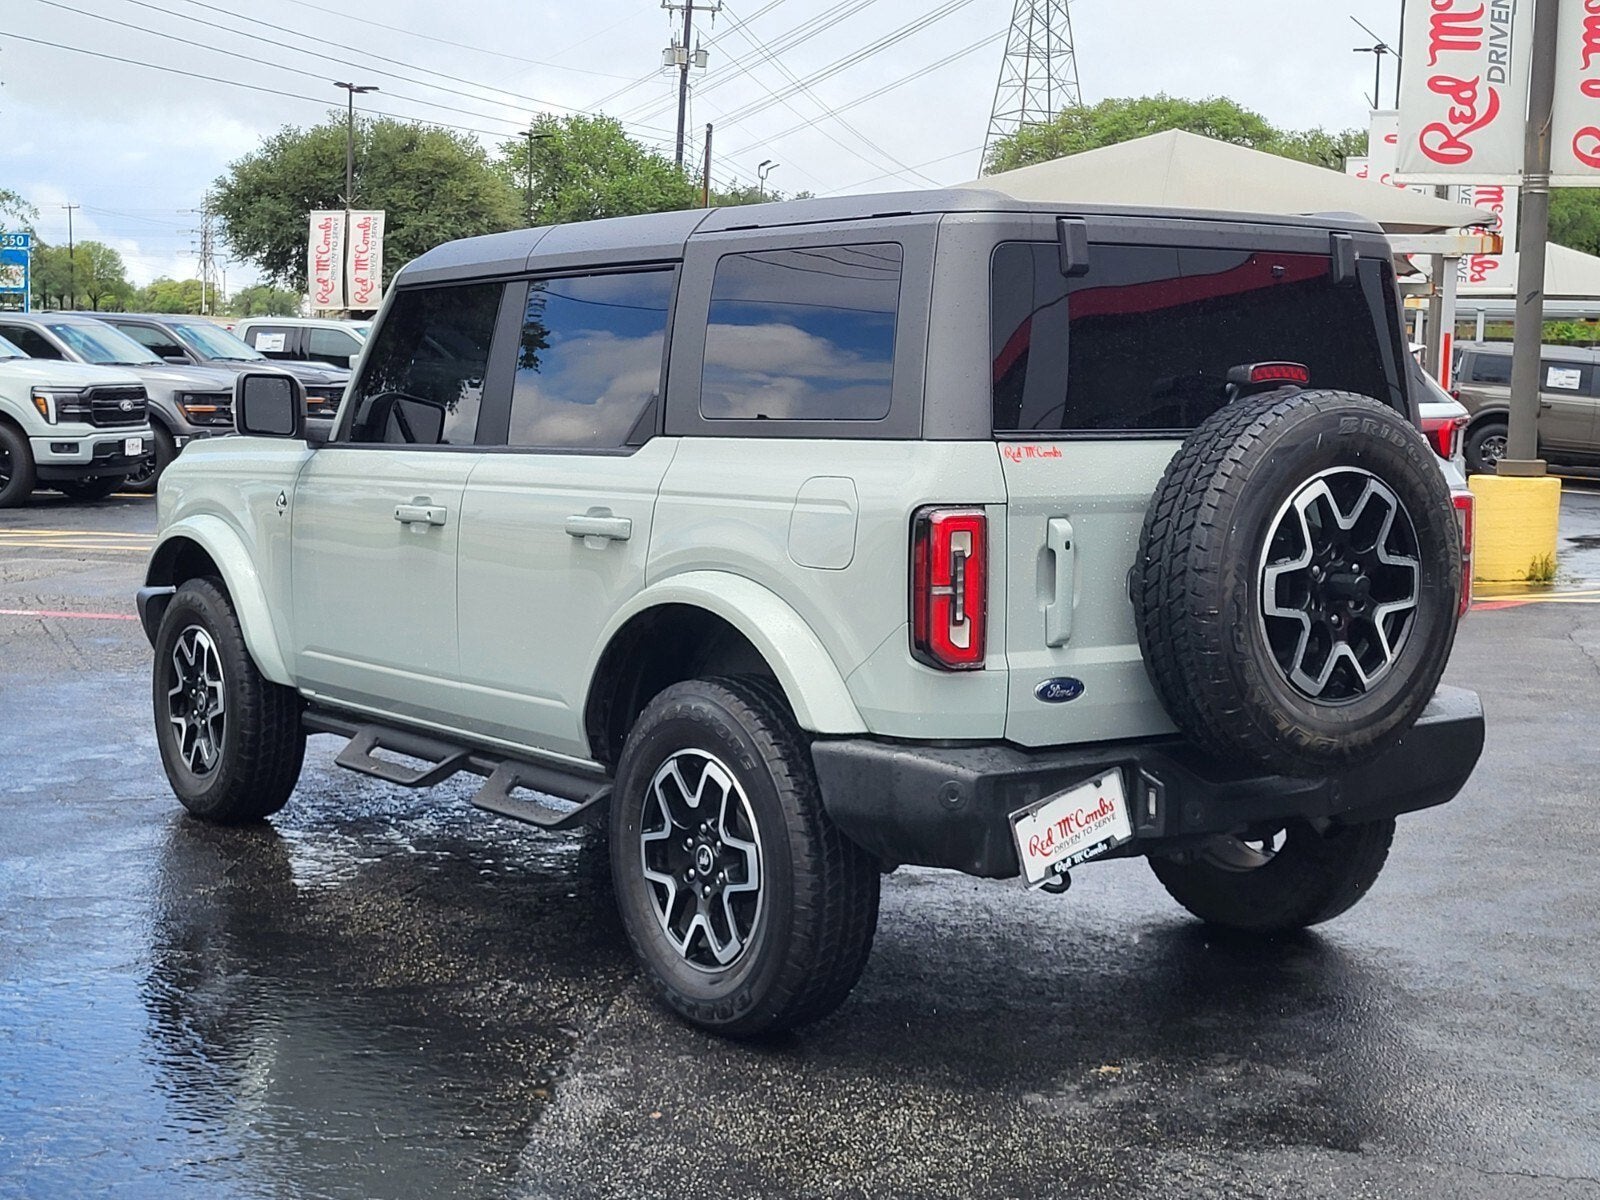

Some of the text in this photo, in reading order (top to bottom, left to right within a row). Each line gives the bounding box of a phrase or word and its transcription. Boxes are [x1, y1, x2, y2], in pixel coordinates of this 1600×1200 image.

[1419, 75, 1500, 165] Red
[315, 217, 334, 304] Red McCombs
[332, 240, 338, 251] TO
[353, 216, 374, 304] Red McCombs
[371, 240, 377, 251] TO
[1004, 445, 1063, 463] Red McCombs
[1029, 797, 1115, 857] Red McCombs
[1053, 813, 1117, 854] DRIVEN TO SERVE
[1054, 857, 1072, 873] Red
